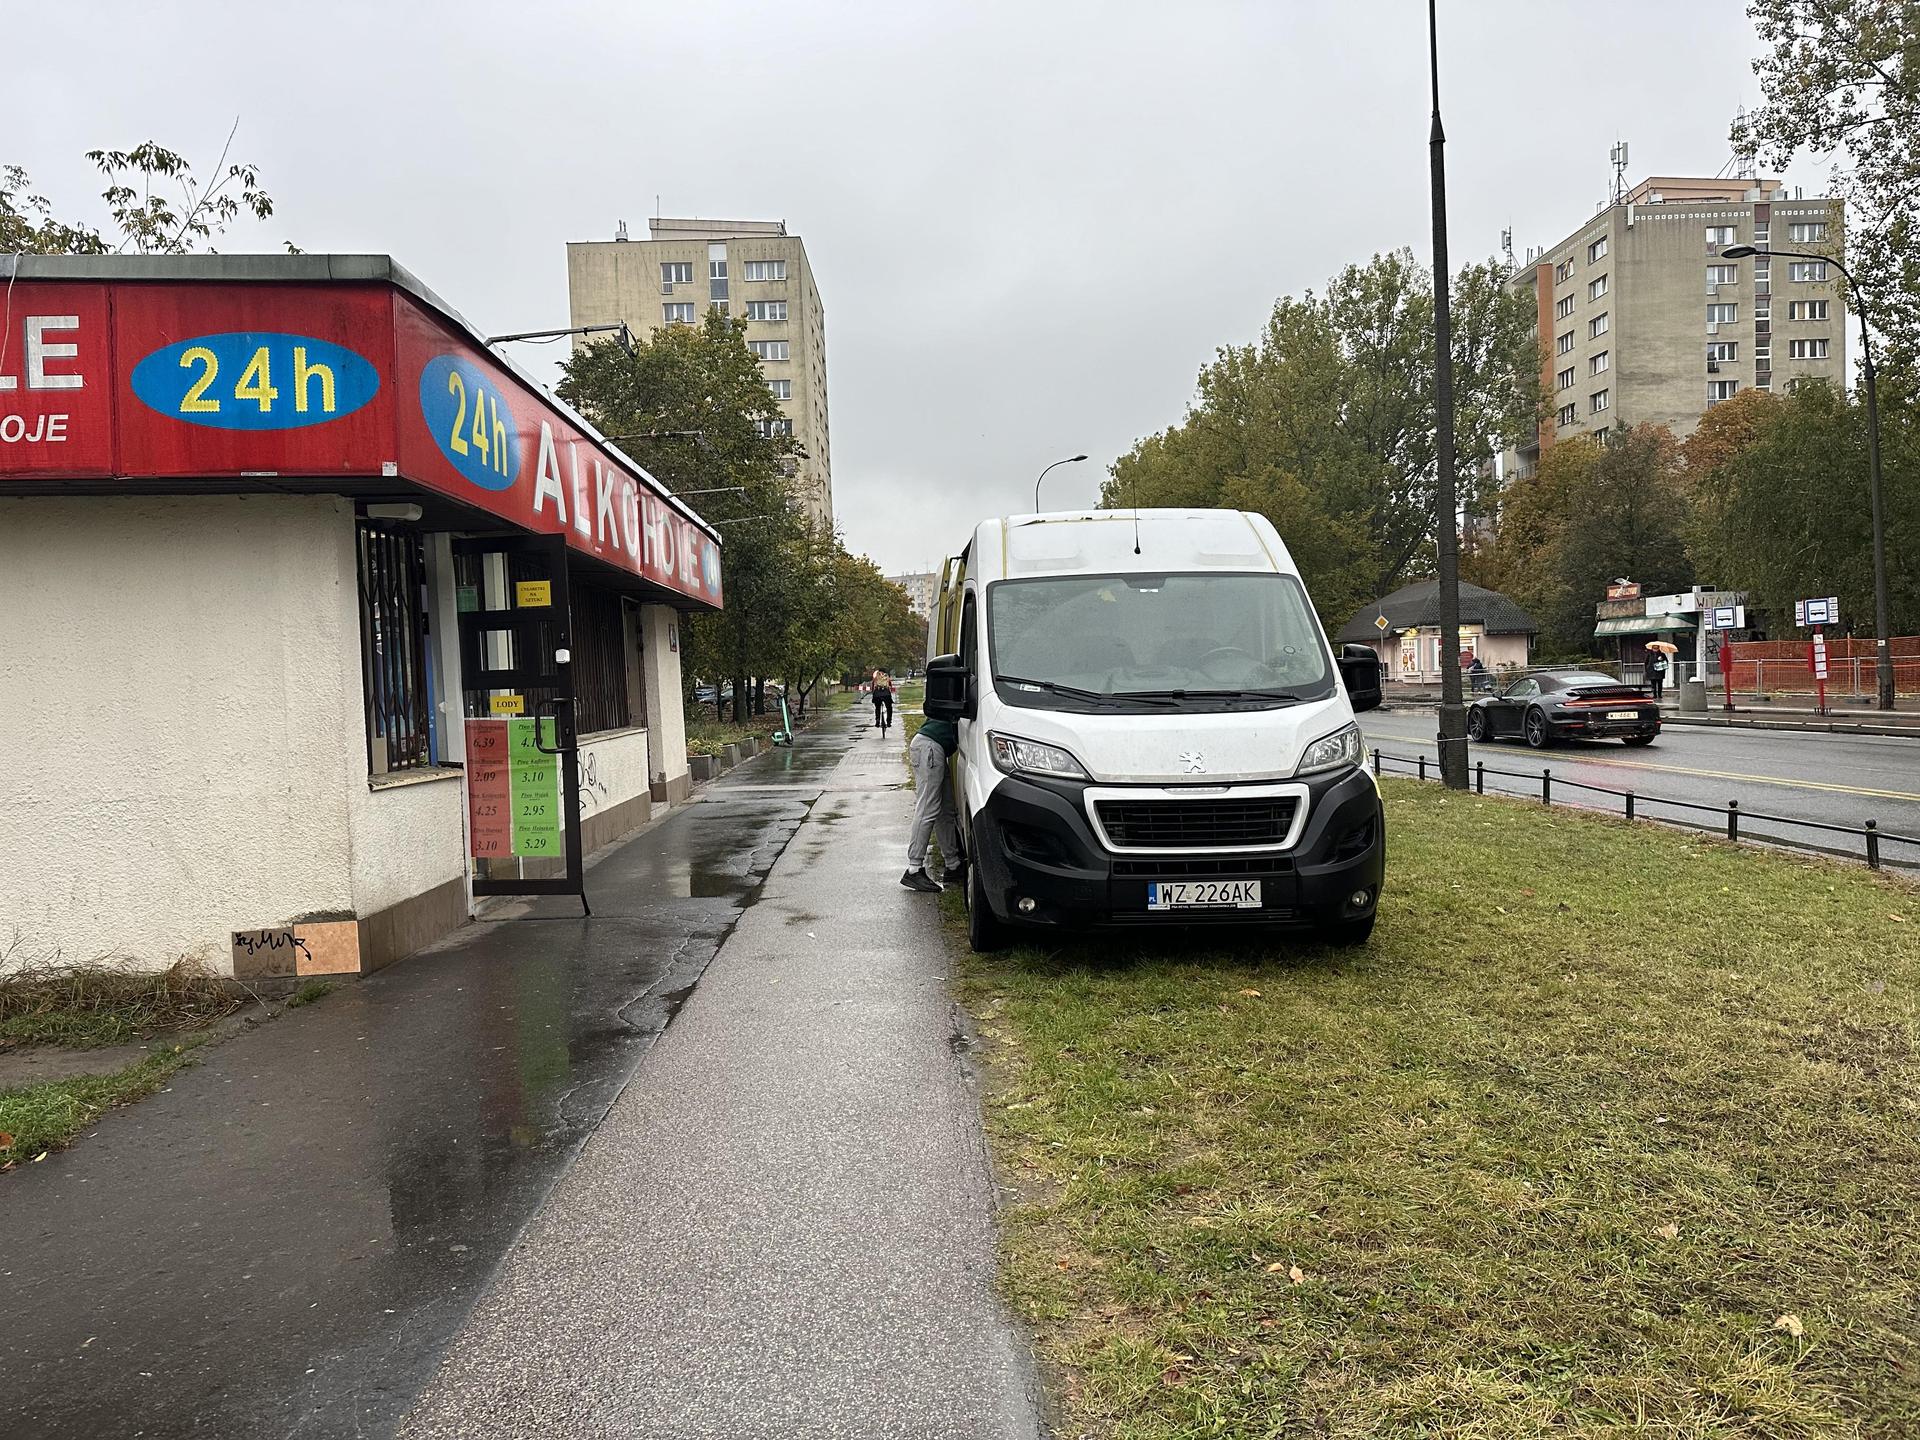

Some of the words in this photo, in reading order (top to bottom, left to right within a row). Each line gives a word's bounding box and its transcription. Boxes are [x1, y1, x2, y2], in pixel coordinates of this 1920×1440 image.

[180, 347, 336, 412] 24h
[0, 414, 69, 443] OJE
[448, 371, 508, 478] 24h
[533, 419, 700, 589] ALKOHOLE
[473, 737, 495, 748] 6.39
[474, 771, 496, 782] 2.09
[521, 772, 544, 783] 3.10
[475, 805, 497, 816] 4.25
[523, 805, 545, 816] 2.95
[475, 841, 497, 851] 3.10
[524, 838, 547, 849] 5.29
[1161, 884, 1187, 903] WZ
[1194, 882, 1256, 903] 226AK
